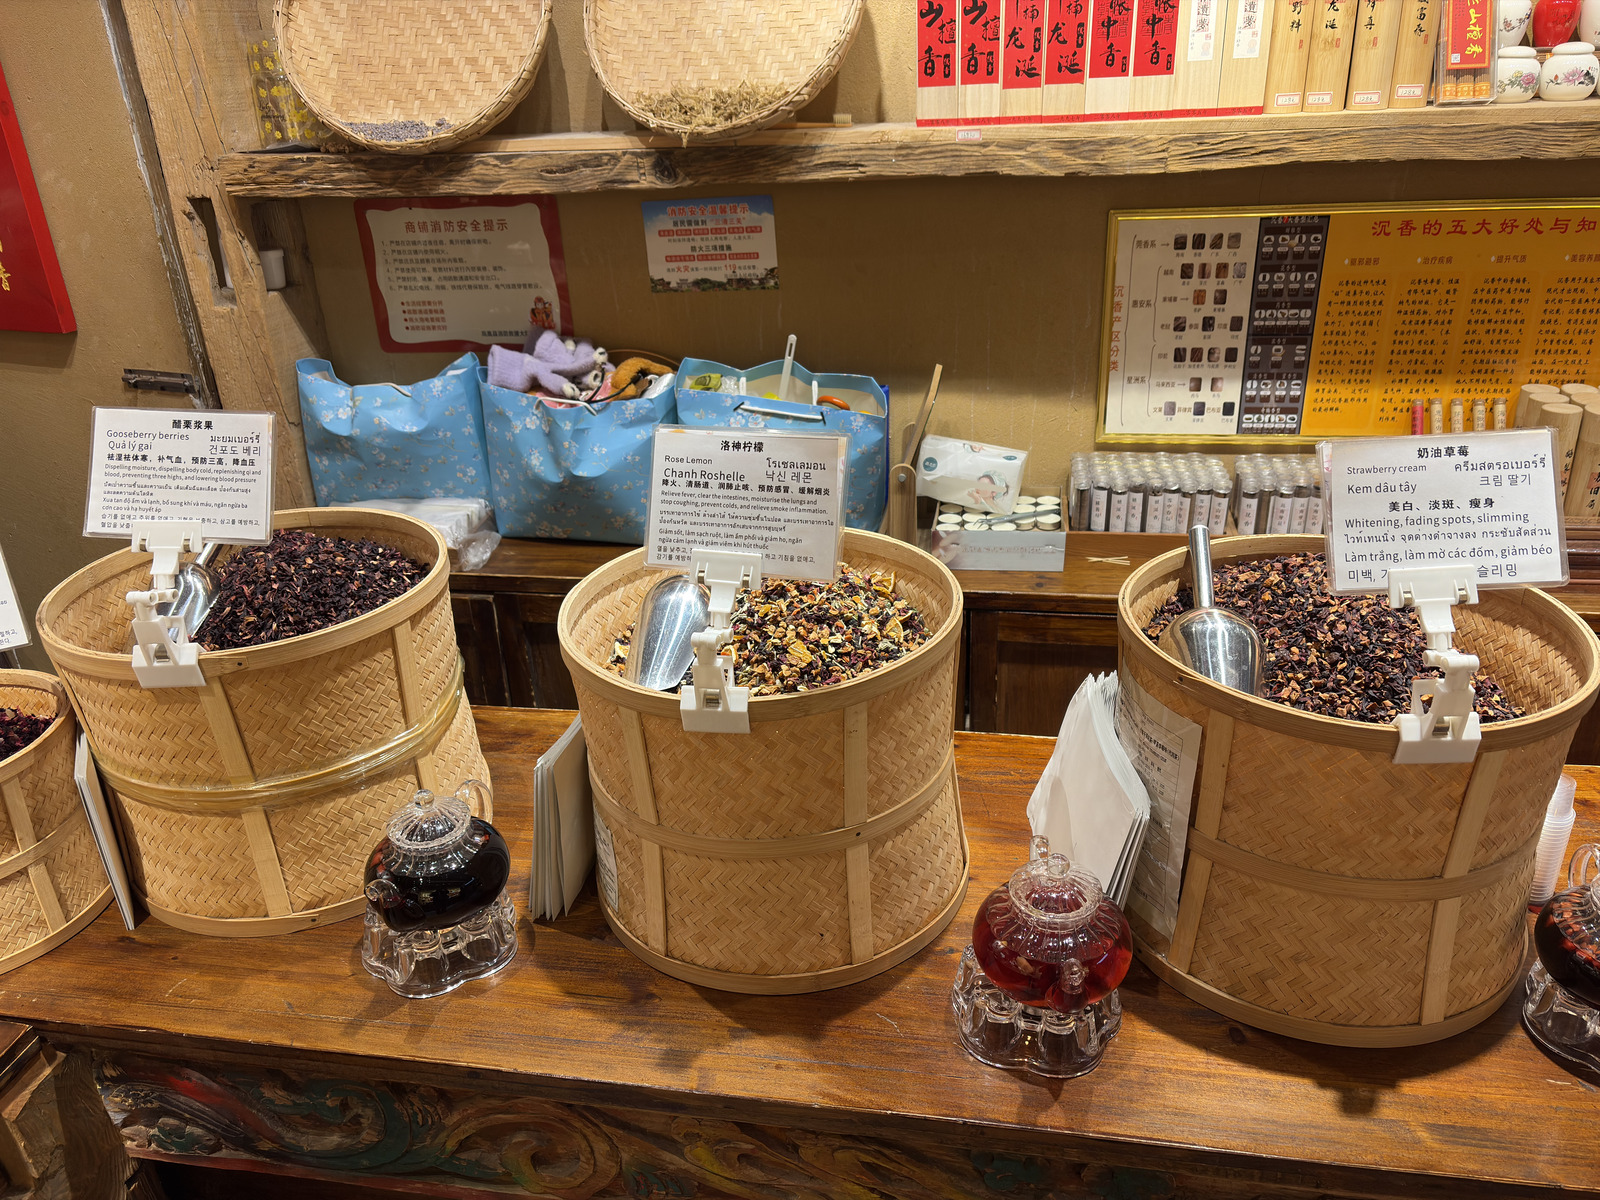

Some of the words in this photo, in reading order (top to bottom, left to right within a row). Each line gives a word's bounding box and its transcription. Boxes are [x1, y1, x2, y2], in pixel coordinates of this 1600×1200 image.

[667, 203, 749, 217] 消防安全温馨提示
[404, 218, 508, 234] 商铺消防安全提示
[1371, 216, 1597, 237] 沉香的五大好处与知
[1422, 256, 1453, 265] 治疗疾病
[1496, 255, 1527, 263] 提升气质
[1110, 286, 1124, 372] 沉香产区分类
[1126, 376, 1146, 385] 星洲系
[172, 419, 213, 430] 醋栗浆果
[106, 430, 156, 441] Gooseberry
[158, 431, 190, 441] berries
[108, 440, 126, 450] Quả
[128, 441, 136, 451] lý
[138, 442, 152, 452] gai
[209, 445, 239, 455] 건포도
[242, 446, 261, 456] 베리
[720, 440, 764, 453] 洛神柠檬
[1416, 445, 1470, 459] 奶油草莓
[664, 455, 685, 463] Rose
[686, 456, 713, 465] Lemon
[158, 465, 185, 473] dispelling
[664, 468, 698, 479] Chanh
[700, 470, 745, 482] Roshelle
[1347, 465, 1397, 475] Strawberry
[1398, 464, 1427, 472] cream
[195, 475, 218, 483] lowering
[766, 470, 786, 482] 낙신
[791, 471, 812, 484] 레몬
[1480, 474, 1502, 487] 크림
[1507, 473, 1531, 486] 딸기
[1347, 484, 1372, 494] Kem
[1375, 482, 1396, 493] dâu
[1399, 481, 1417, 494] tây
[721, 493, 749, 501] intestines,
[673, 500, 700, 508] coughing,
[789, 506, 828, 514] inflammation.
[1388, 497, 1495, 512] 美白、淡斑、瘦身
[1344, 517, 1403, 529] Whitening,
[1405, 515, 1440, 527] fading
[1441, 514, 1475, 527] spots,
[1477, 512, 1529, 524] slimming
[696, 530, 709, 538] sạch
[764, 535, 778, 543] giảm
[685, 537, 698, 545] lạnh
[705, 539, 719, 547] giảm
[753, 542, 769, 550] thuốc
[1345, 551, 1367, 562] Làm
[1370, 549, 1403, 563] trắng,
[1405, 549, 1425, 560] làm
[1428, 548, 1446, 559] mờ
[1448, 547, 1467, 558] các
[1500, 545, 1528, 559] giảm
[1531, 544, 1553, 555] béo
[1348, 569, 1376, 583] 미백,
[1477, 563, 1517, 578] 슬리밍
